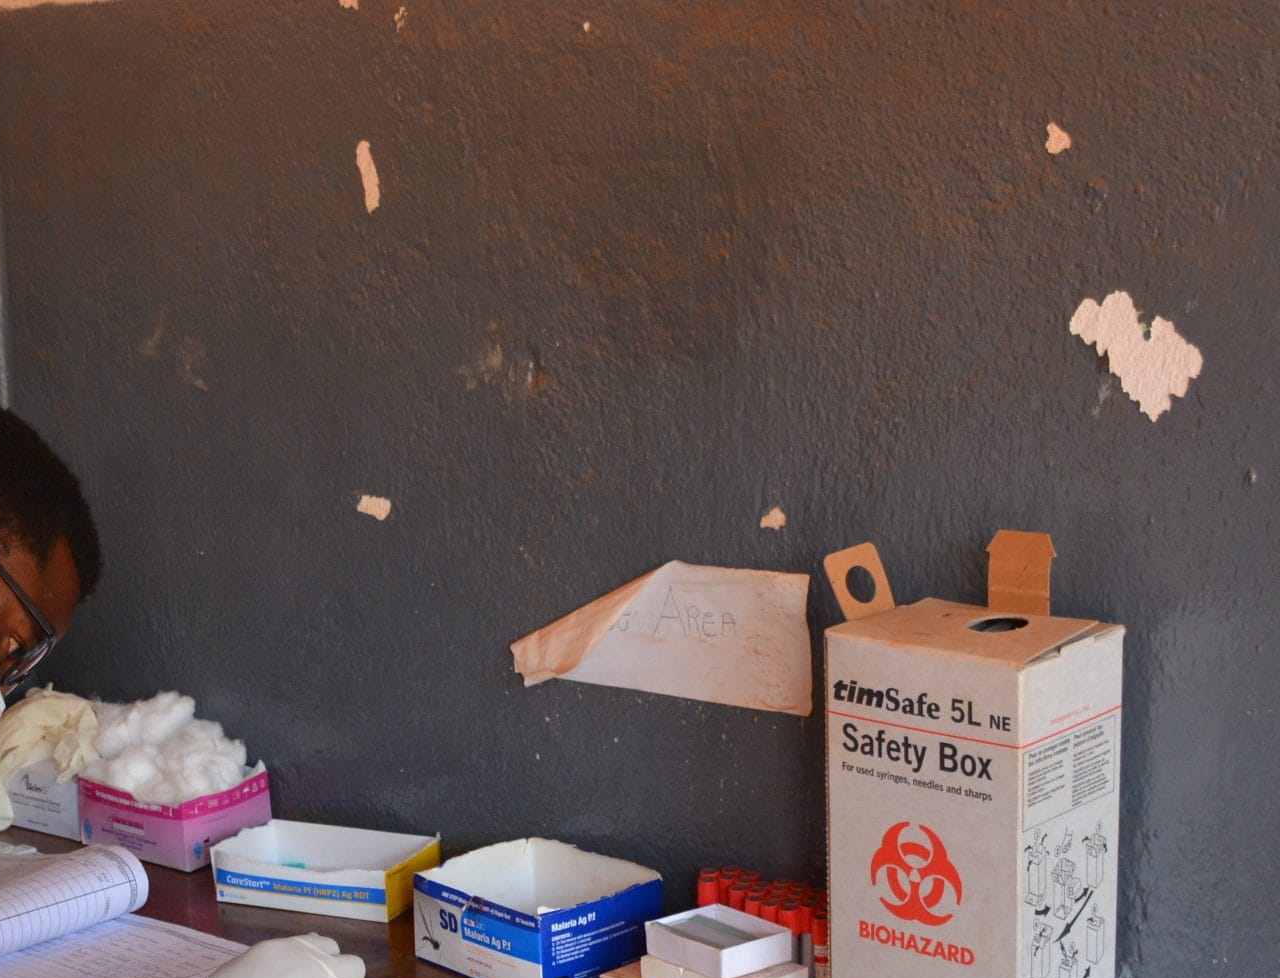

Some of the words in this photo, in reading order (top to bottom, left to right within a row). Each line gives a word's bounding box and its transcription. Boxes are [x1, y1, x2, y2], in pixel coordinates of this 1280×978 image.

[833, 680, 940, 719] timSafe
[950, 698, 981, 727] 5L
[989, 714, 1011, 732] NE
[842, 722, 927, 773] Safety
[939, 741, 993, 780] Box
[842, 761, 854, 772] For
[856, 765, 874, 777] used
[876, 769, 910, 786] syringes,
[913, 778, 944, 792] needles
[946, 785, 962, 796] and
[964, 788, 993, 802] sharps
[273, 882, 302, 894] Malaria
[354, 891, 370, 901] RDT
[439, 908, 458, 934] SD
[551, 918, 577, 933] Malaria
[578, 915, 587, 925] Ag
[464, 927, 490, 945] Malaria
[491, 936, 501, 950] Ag
[859, 919, 975, 966] BIOHAZARD
